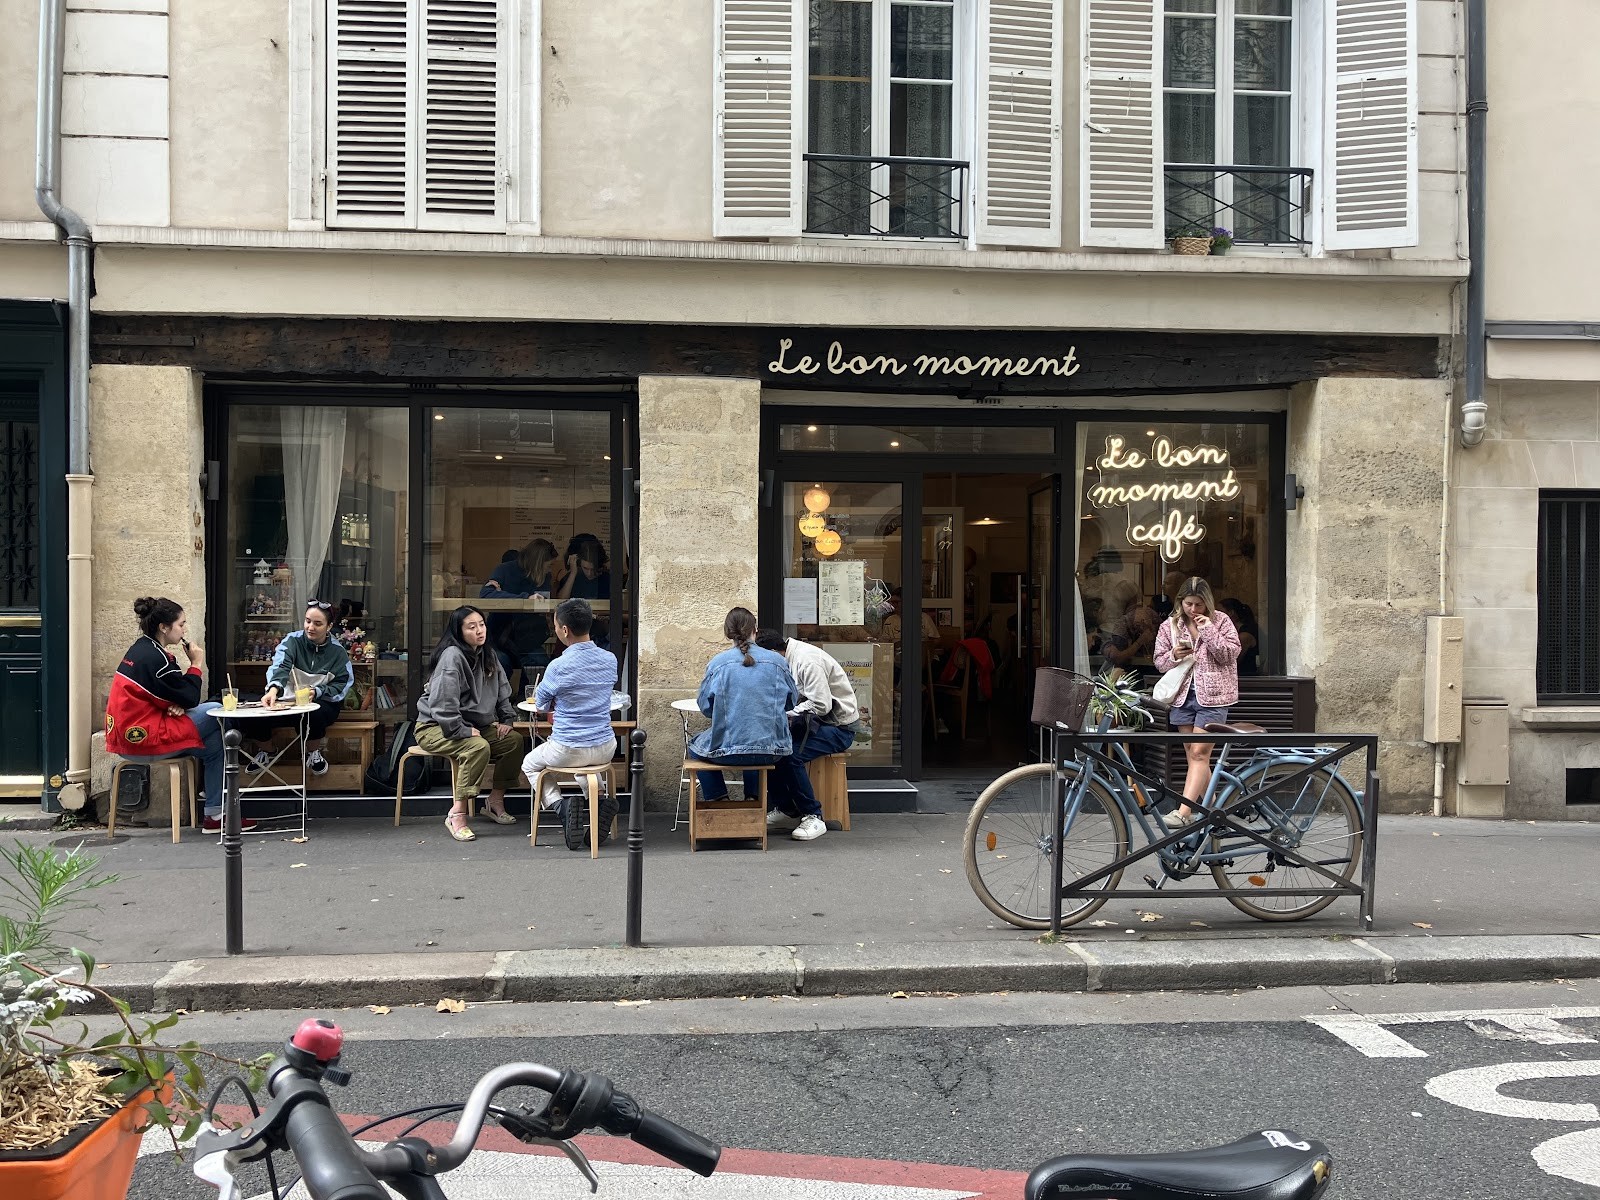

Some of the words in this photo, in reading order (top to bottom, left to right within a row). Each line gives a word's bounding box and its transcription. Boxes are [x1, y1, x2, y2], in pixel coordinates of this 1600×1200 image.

[768, 338, 821, 375] Le
[827, 341, 908, 376] bon
[913, 346, 1081, 377] moment
[1101, 437, 1147, 469] Le
[1157, 439, 1228, 468] bon
[1093, 470, 1239, 504] moment
[1132, 509, 1204, 559] café
